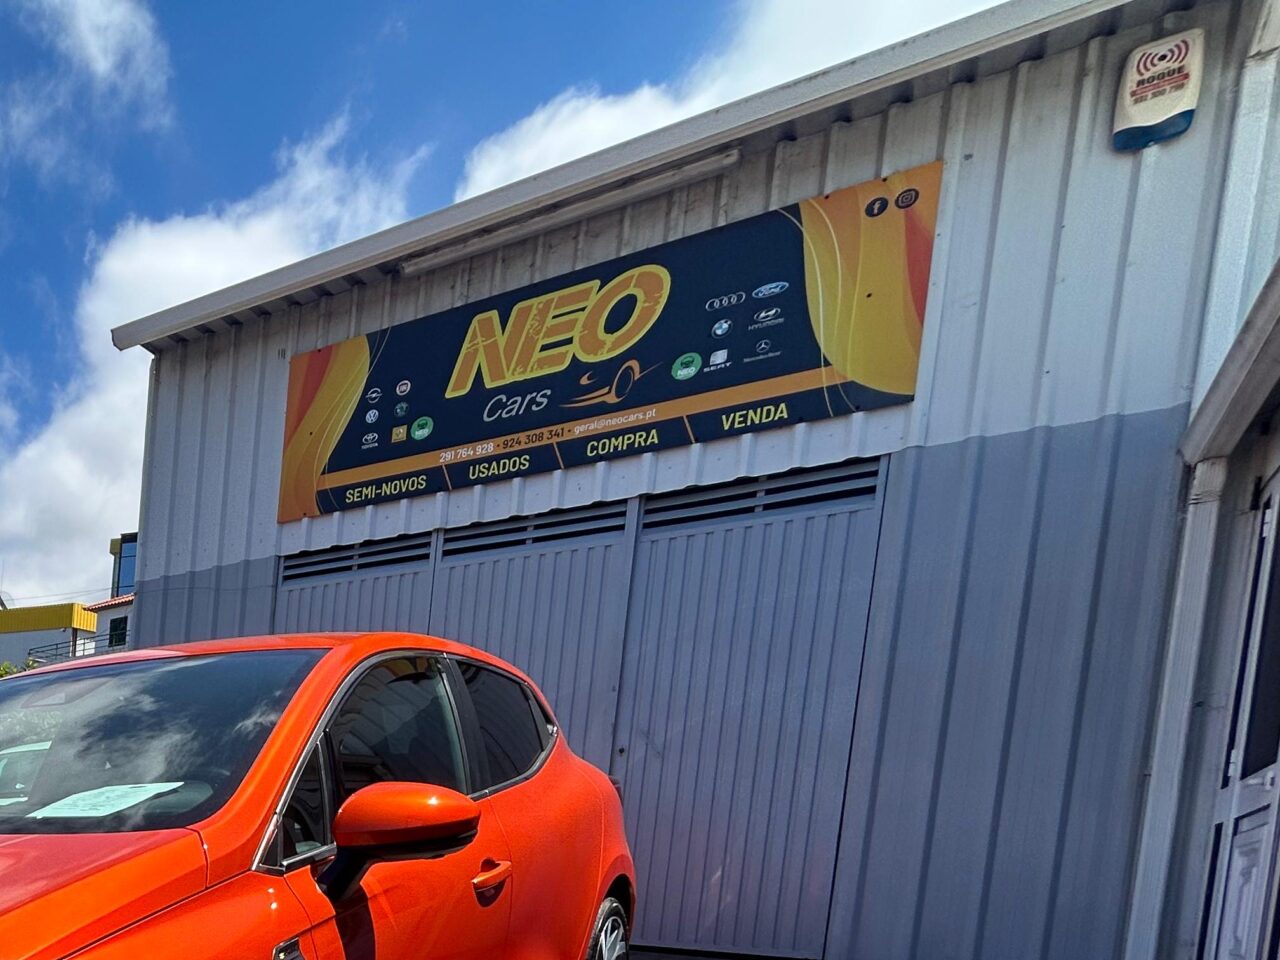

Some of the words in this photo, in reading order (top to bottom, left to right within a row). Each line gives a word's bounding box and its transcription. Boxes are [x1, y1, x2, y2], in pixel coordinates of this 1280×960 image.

[445, 264, 671, 399] NEO
[483, 389, 552, 423] Cars
[721, 402, 789, 431] VENDA
[440, 452, 455, 463] 291
[457, 447, 474, 459] 764
[475, 442, 495, 455] 928
[502, 438, 522, 449] 924
[524, 432, 544, 445] 308
[546, 427, 565, 440] 341
[574, 408, 656, 435] geral@neocars.pt
[586, 429, 659, 457] COMPRA
[469, 455, 530, 480] USADOS
[345, 475, 427, 503] SEMI-NOVOS
